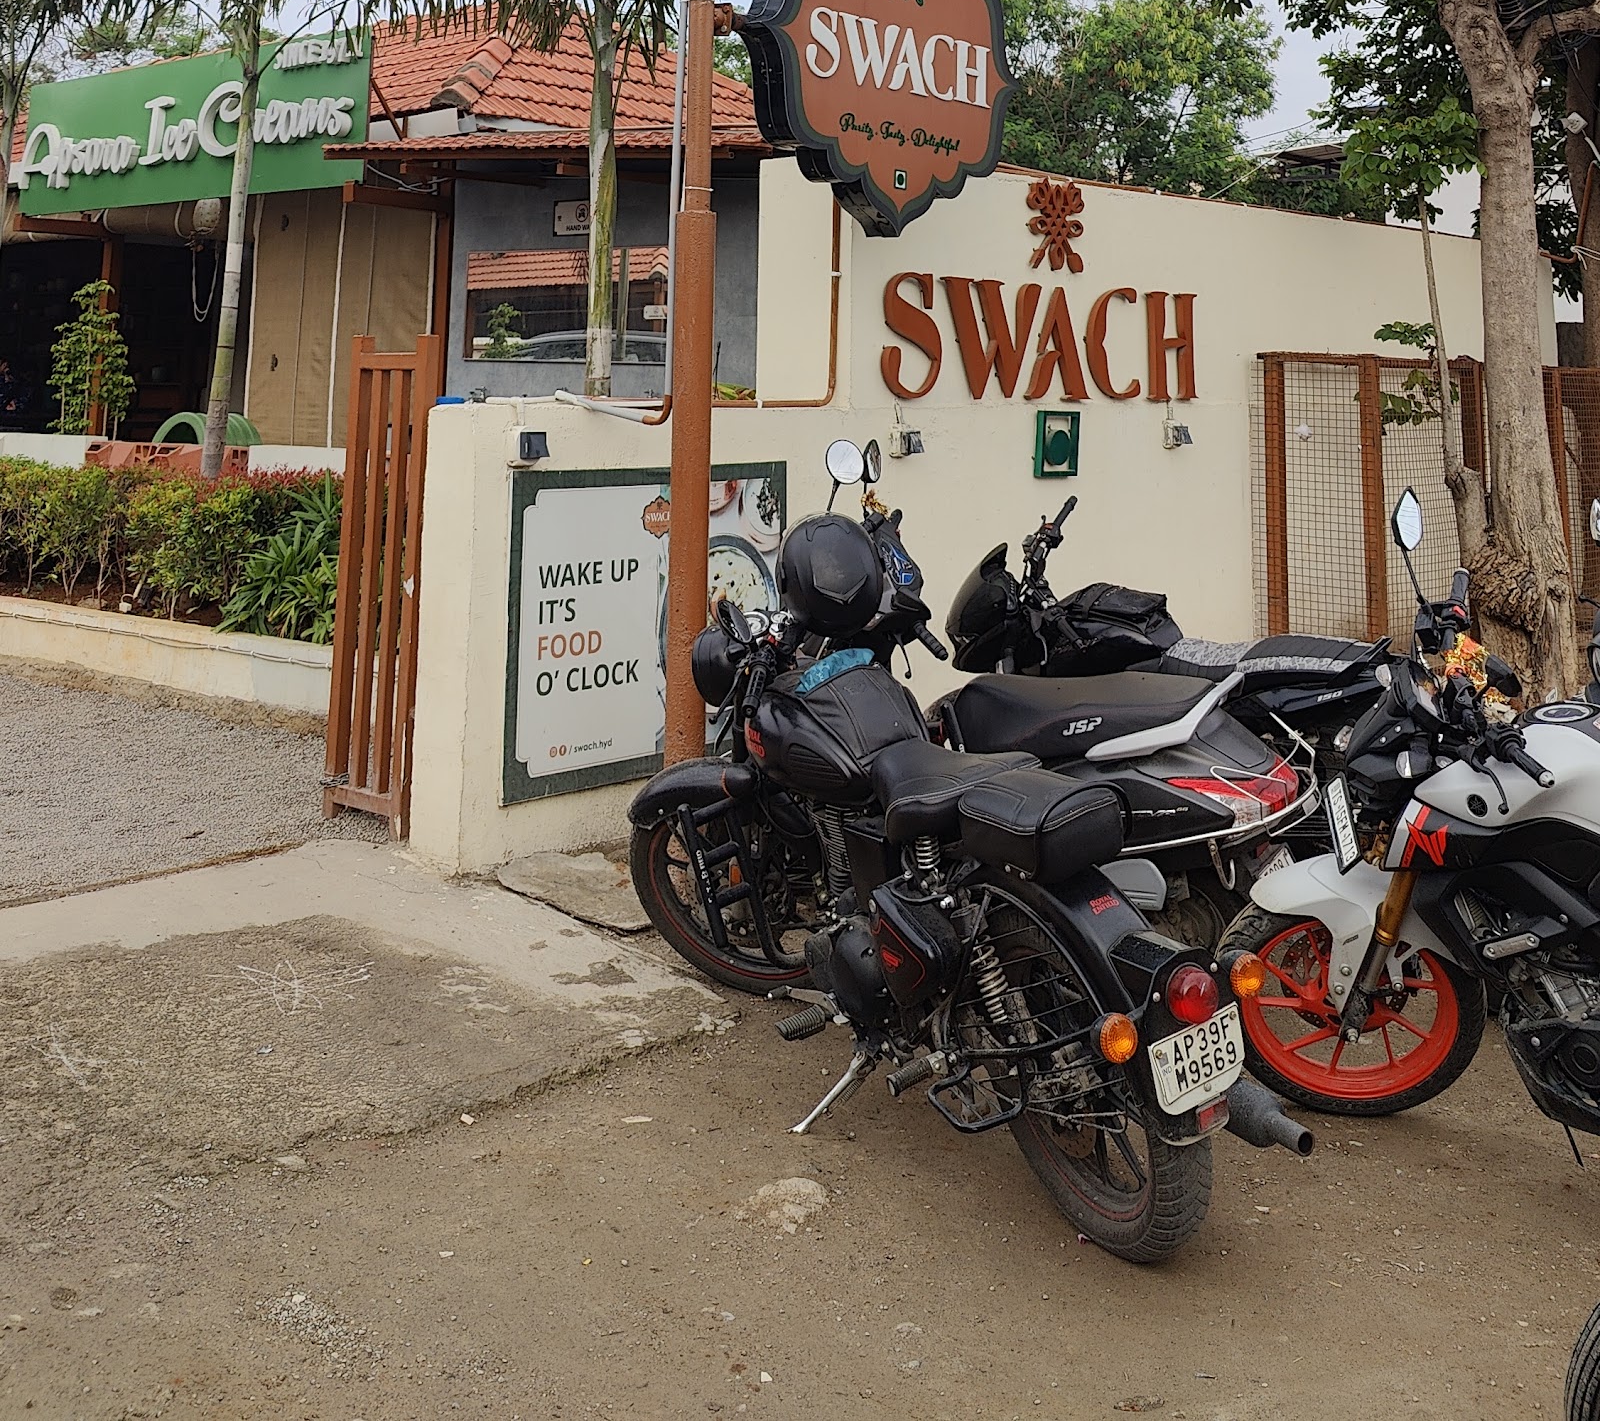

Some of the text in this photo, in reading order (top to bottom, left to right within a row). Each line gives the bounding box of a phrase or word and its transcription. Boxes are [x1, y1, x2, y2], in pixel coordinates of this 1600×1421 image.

[805, 6, 991, 109] SWACH
[9, 123, 141, 189] Apsara
[138, 96, 199, 166] Ice
[839, 112, 961, 157] Purity Tasty Delightful
[881, 271, 1199, 402] SWACH
[538, 558, 639, 590] WAKE UP
[538, 598, 576, 625] IT'S
[537, 630, 602, 660] FOOD
[566, 659, 639, 693] CLOCK
[1316, 690, 1343, 703] 150
[1062, 716, 1103, 736] JSP
[1089, 894, 1113, 907] ROYAL
[1174, 1014, 1229, 1065] AP39F
[1175, 1041, 1236, 1092] M9569
